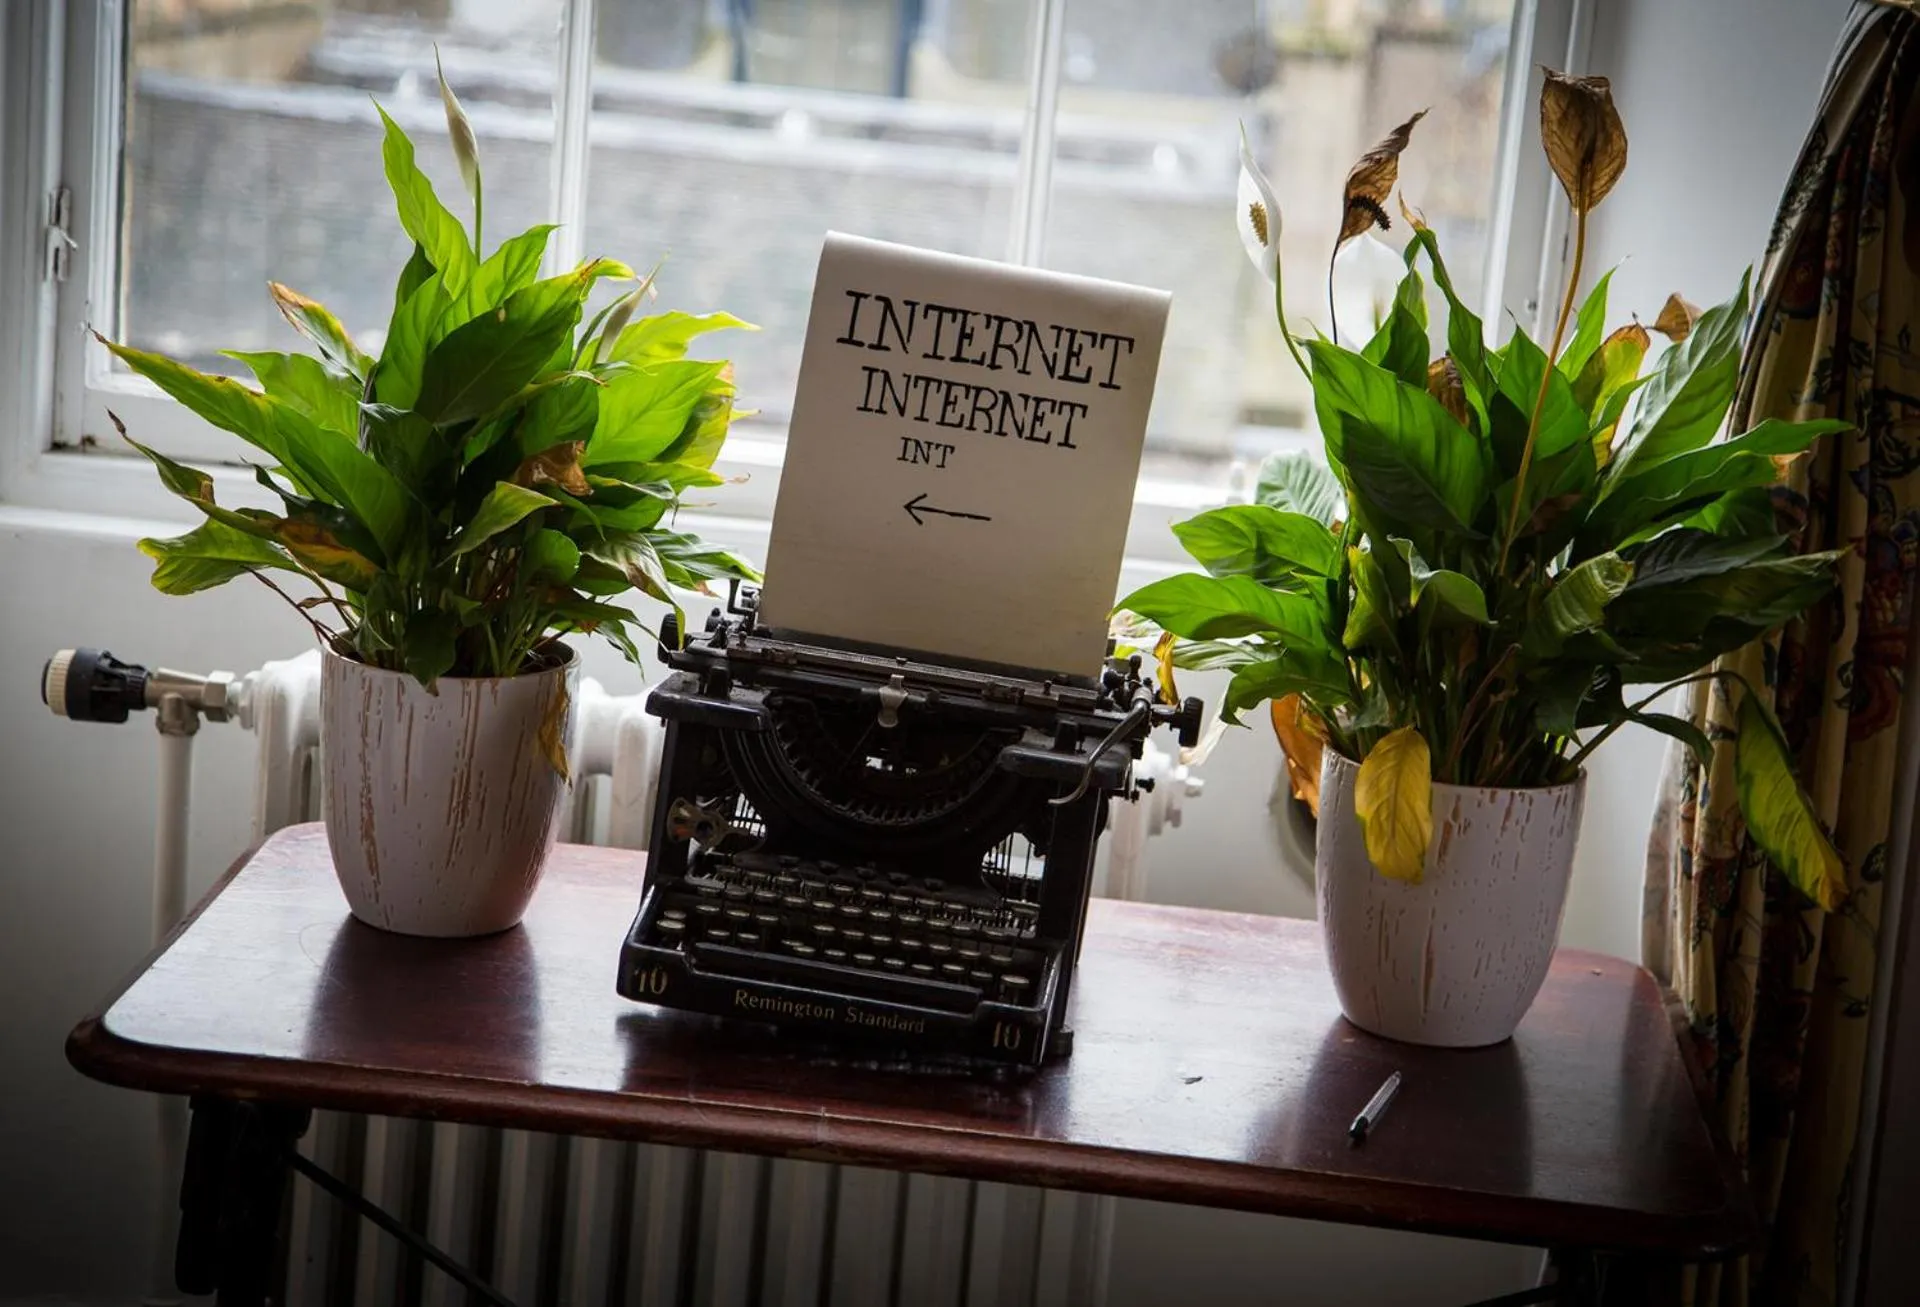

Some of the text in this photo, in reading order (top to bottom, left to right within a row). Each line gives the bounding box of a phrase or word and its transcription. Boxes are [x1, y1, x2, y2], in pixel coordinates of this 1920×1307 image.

[836, 290, 1135, 390] INTERNET
[856, 365, 1089, 449] INTERNET
[896, 436, 955, 468] INT
[634, 963, 668, 995] 10
[734, 988, 926, 1035] Remington Standard
[992, 1021, 1022, 1050] 10
